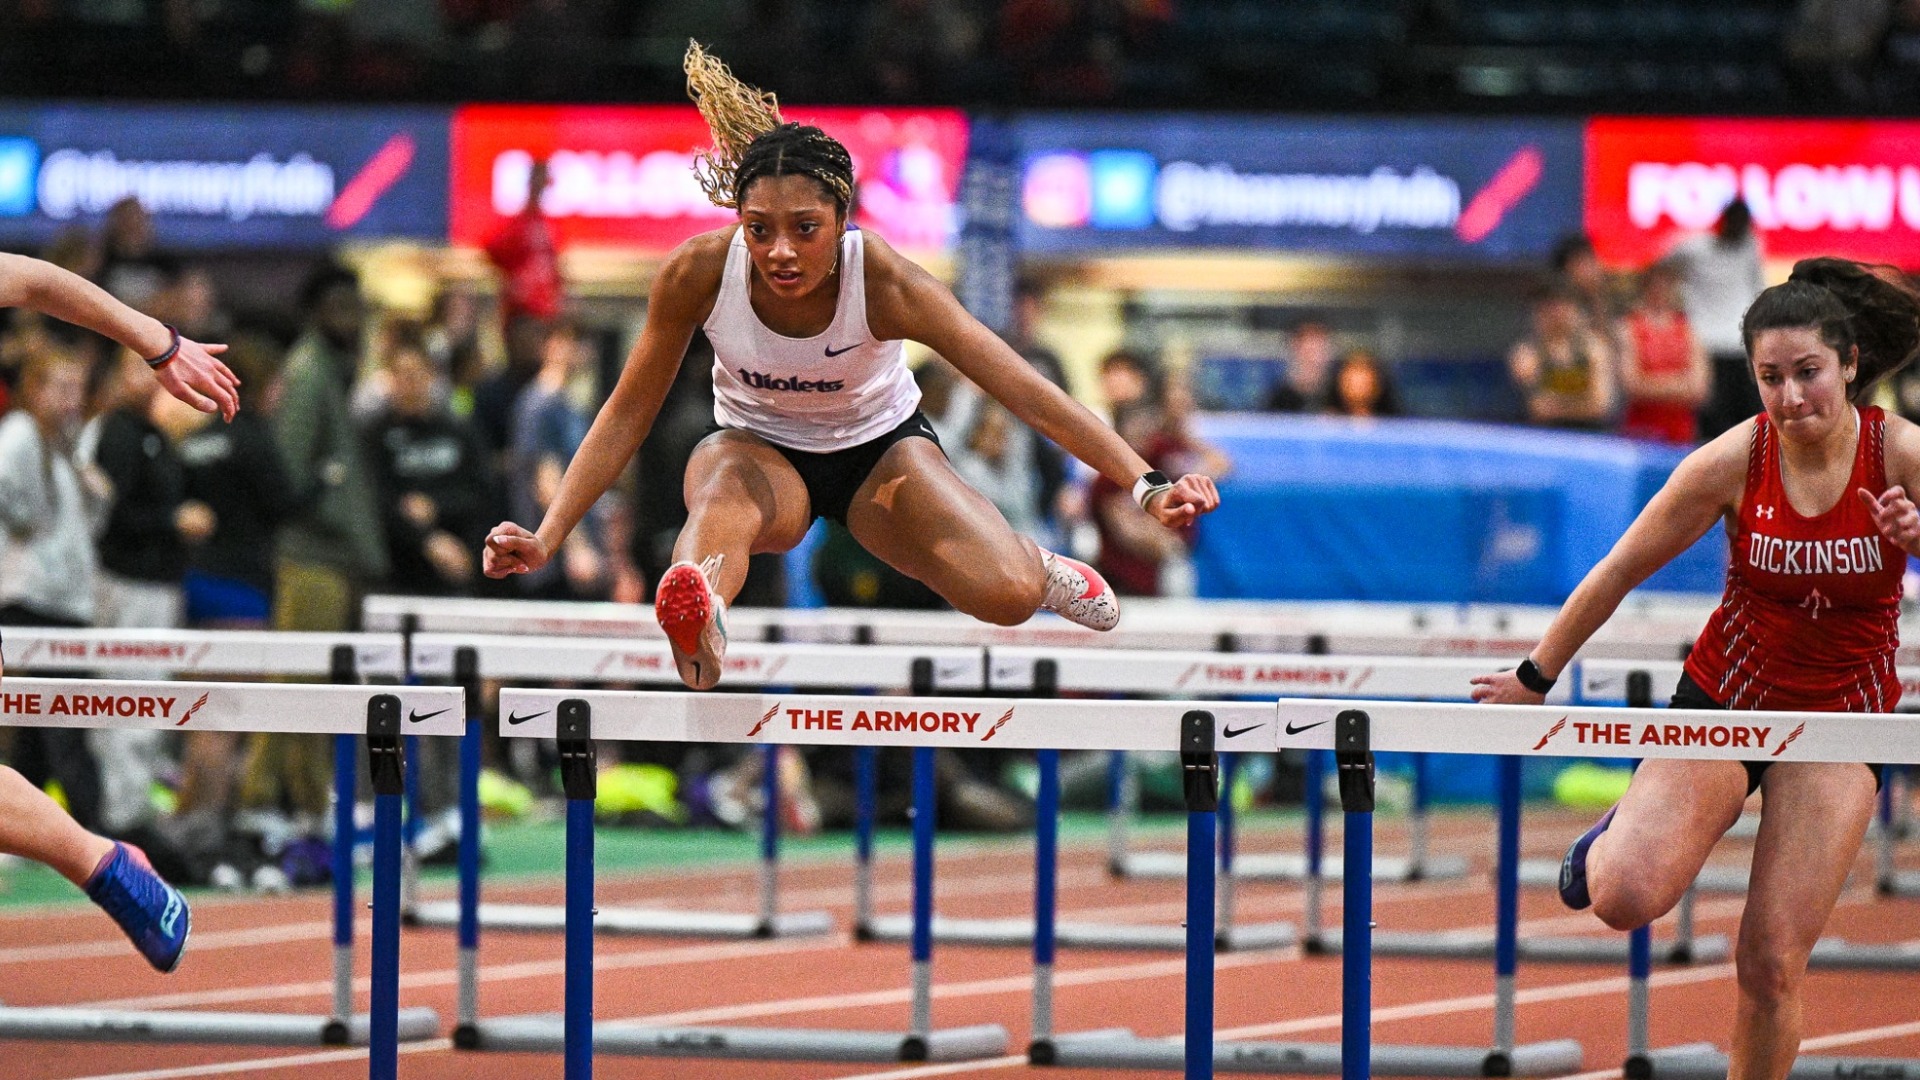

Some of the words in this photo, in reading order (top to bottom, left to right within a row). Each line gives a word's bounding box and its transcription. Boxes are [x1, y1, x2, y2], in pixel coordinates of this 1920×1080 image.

[737, 367, 844, 392] Violets
[1749, 532, 1883, 575] DICKINSON
[0, 693, 41, 714] HE
[49, 695, 176, 717] ARMORY
[787, 709, 843, 730] THE
[851, 711, 981, 733] ARMORY
[1573, 723, 1631, 744] THE
[1639, 724, 1771, 747] ARMORY
